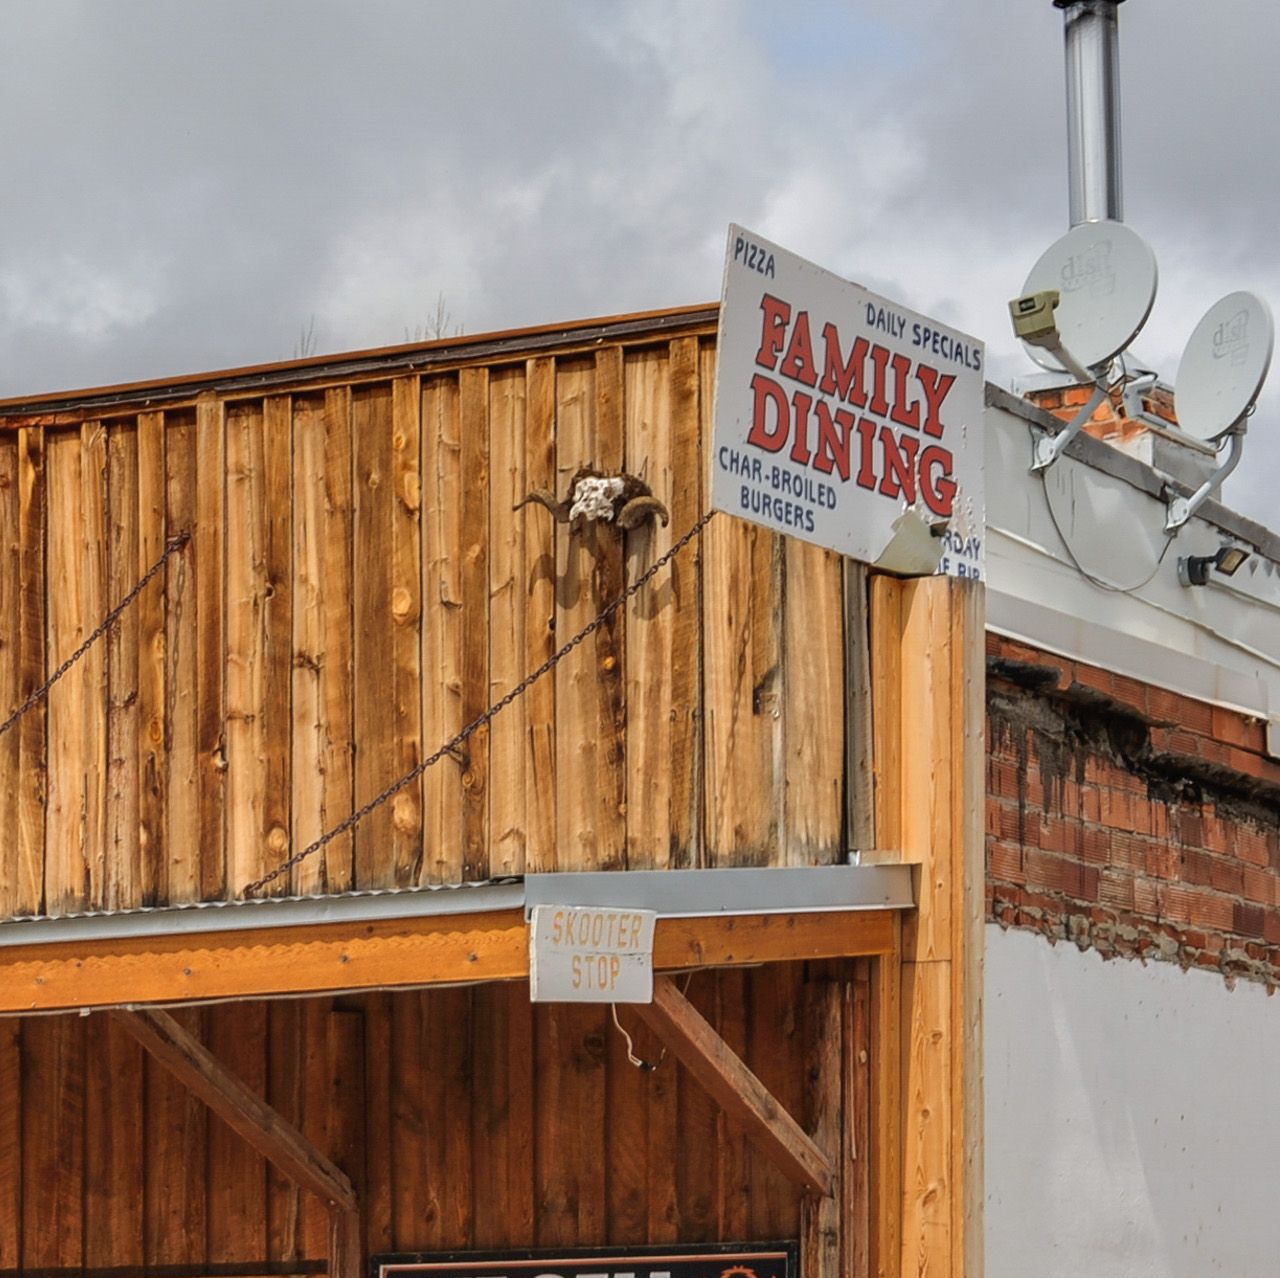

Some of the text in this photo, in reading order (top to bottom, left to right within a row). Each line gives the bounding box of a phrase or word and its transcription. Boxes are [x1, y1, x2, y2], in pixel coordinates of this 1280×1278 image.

[734, 236, 775, 280] PIZZA
[866, 301, 981, 372] DAILY SPECIALS
[756, 293, 957, 440] FAMILY
[747, 373, 958, 518] DINING
[718, 445, 837, 510] CHAR-BROILED
[741, 484, 815, 532] BURGERS
[552, 911, 644, 949] SKOOTER
[571, 955, 621, 991] STOP
